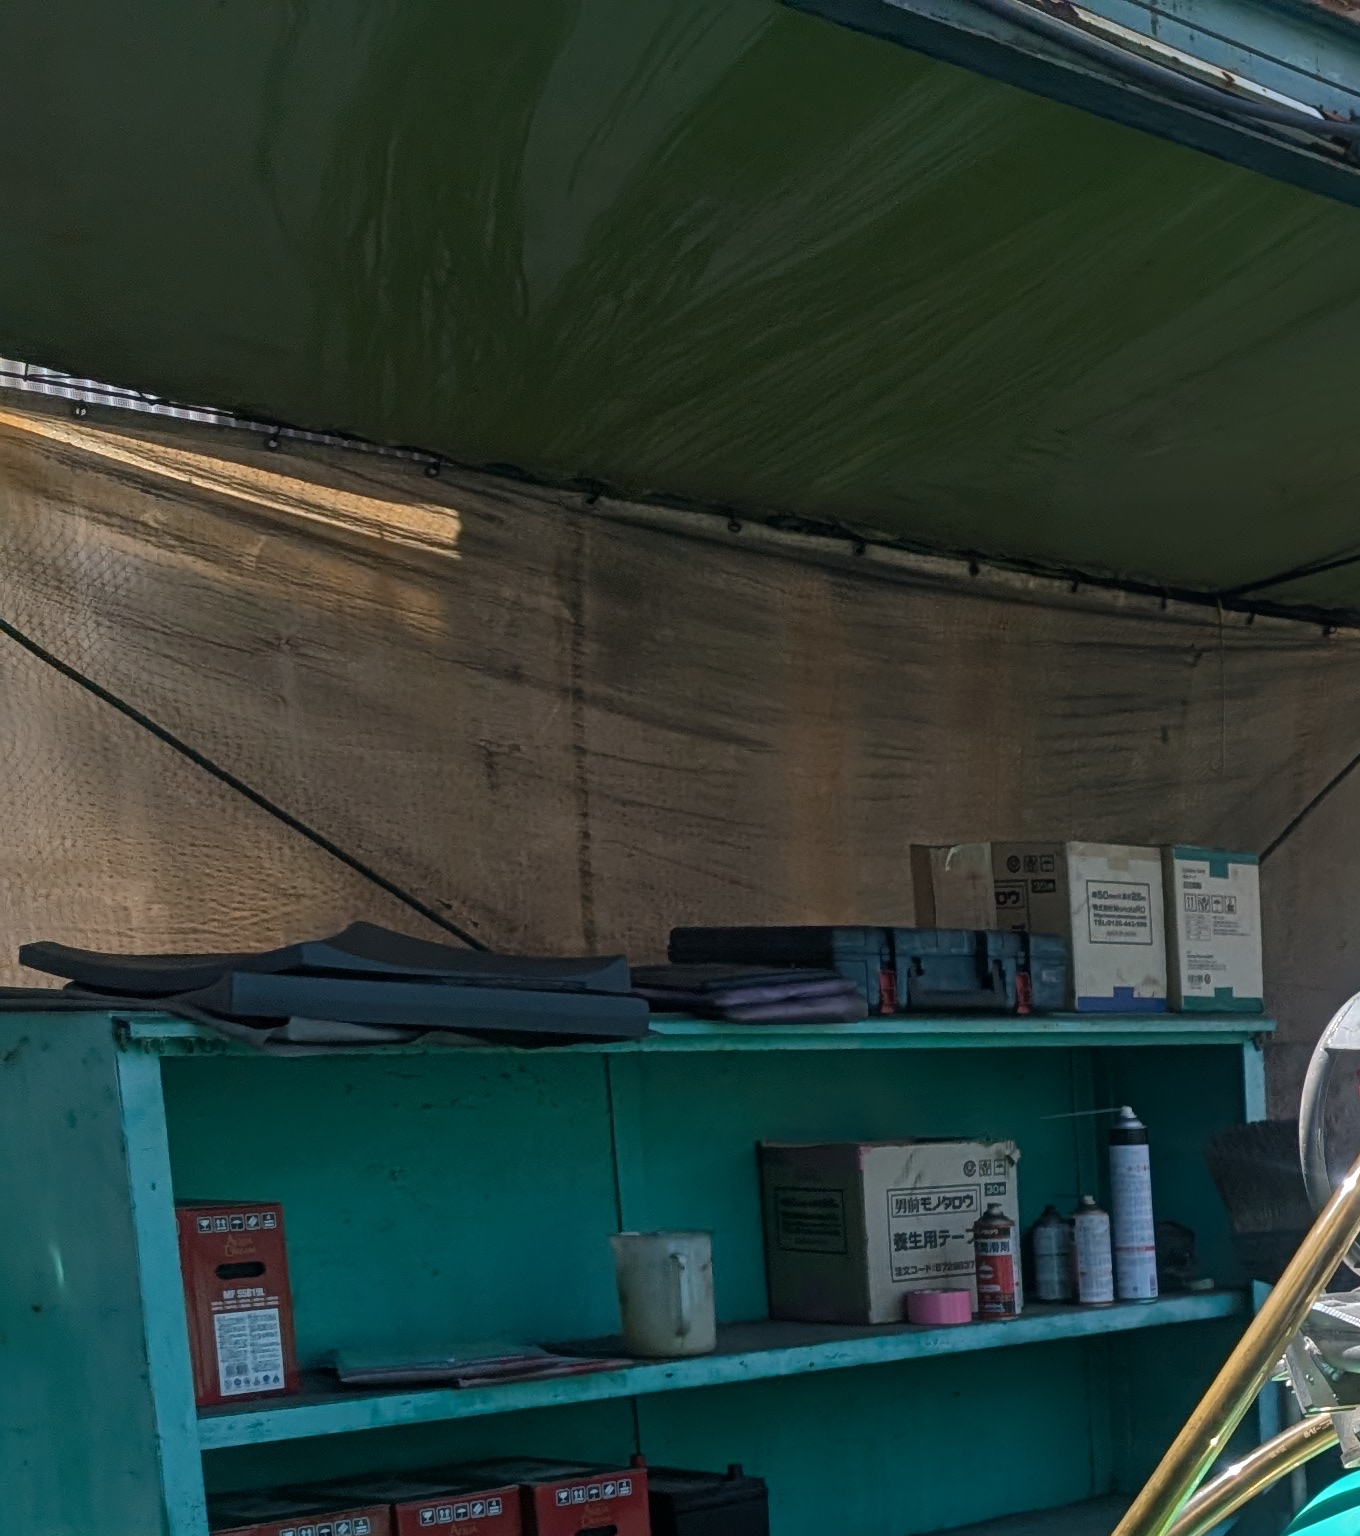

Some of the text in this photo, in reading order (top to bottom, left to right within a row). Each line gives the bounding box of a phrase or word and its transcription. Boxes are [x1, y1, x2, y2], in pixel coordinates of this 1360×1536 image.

[895, 1194, 974, 1215] 男前モノタロウ
